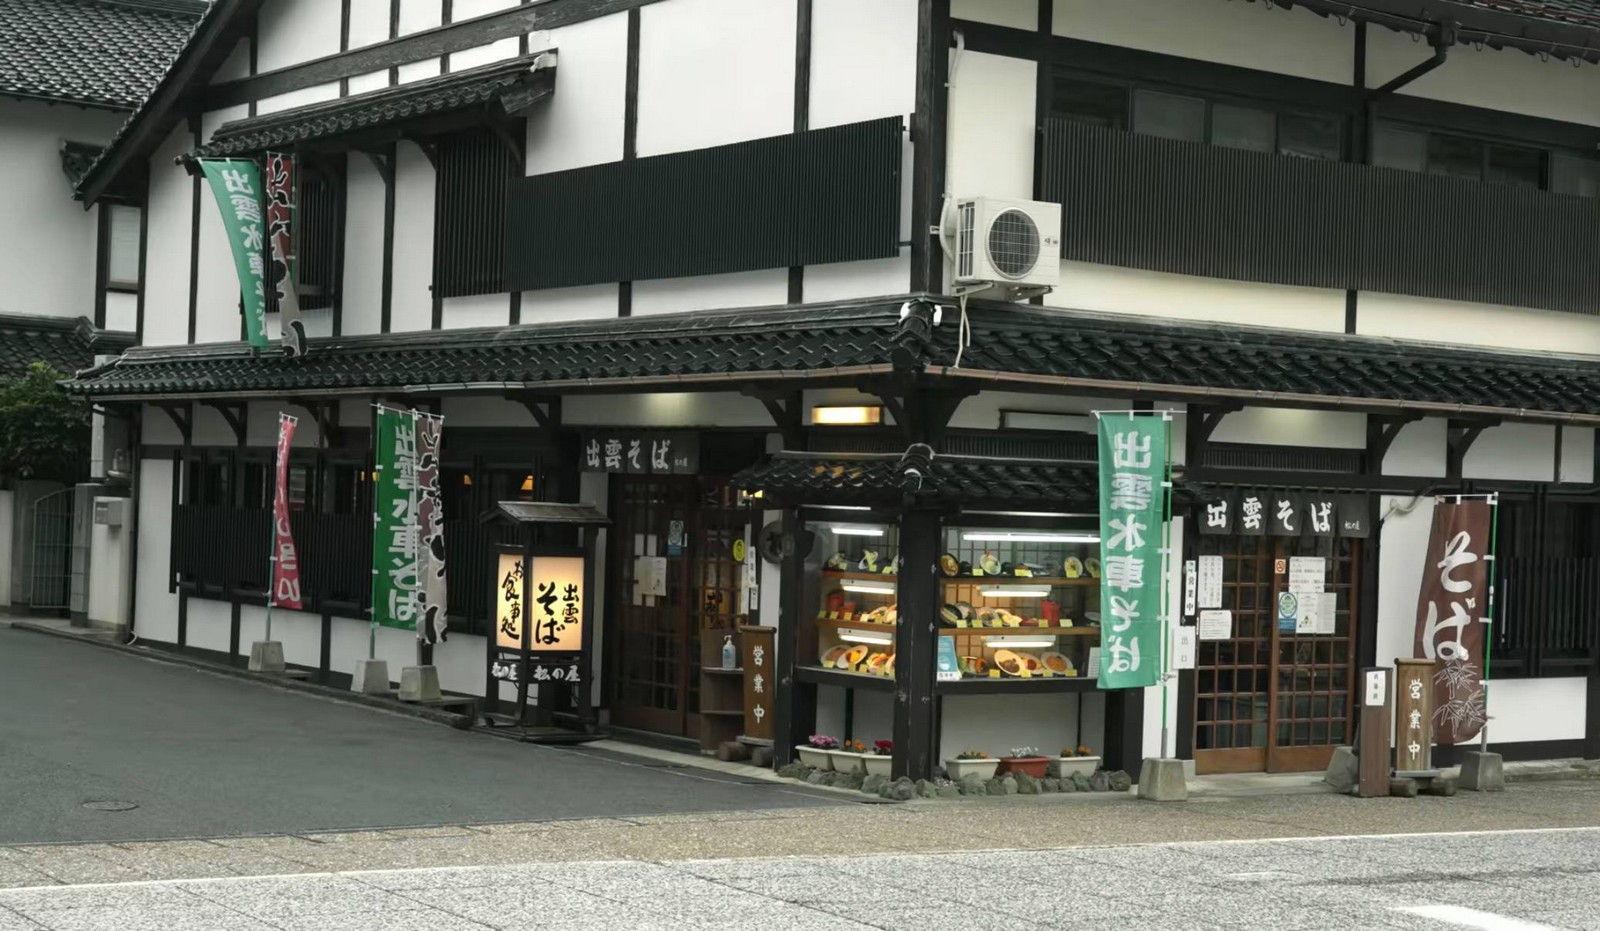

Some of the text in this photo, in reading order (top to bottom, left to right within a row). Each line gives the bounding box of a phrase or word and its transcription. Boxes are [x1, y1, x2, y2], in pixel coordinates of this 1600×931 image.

[586, 438, 670, 469] 出雲そば
[1207, 497, 1333, 532] 出雲そば
[501, 560, 524, 640] お食事処
[535, 581, 566, 645] そば
[562, 583, 579, 624] 出雲
[1422, 530, 1478, 661] そば
[533, 664, 581, 681] 松の屋
[752, 645, 764, 724] 営業中
[1408, 678, 1423, 761] 営業中
